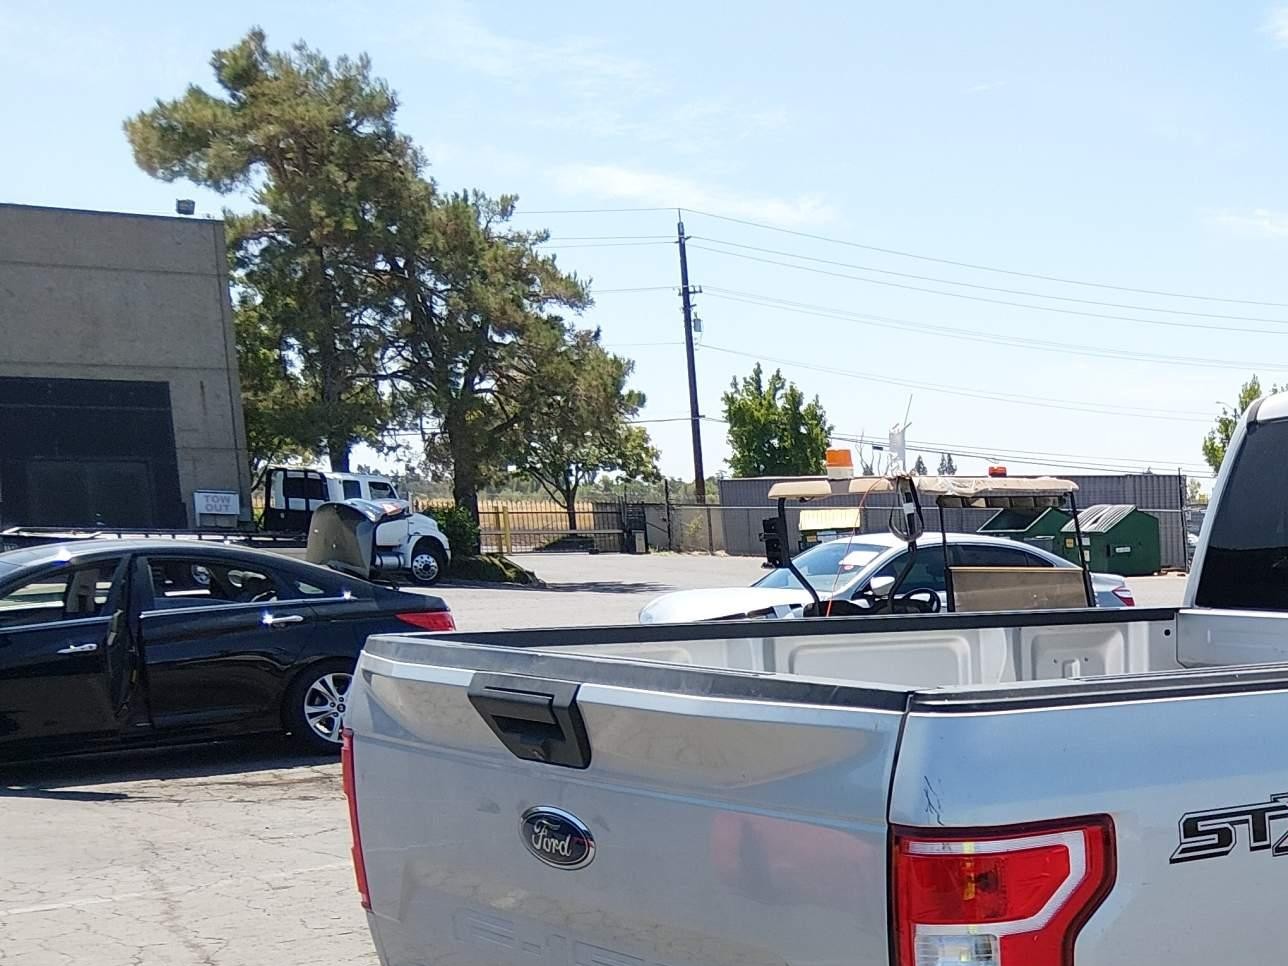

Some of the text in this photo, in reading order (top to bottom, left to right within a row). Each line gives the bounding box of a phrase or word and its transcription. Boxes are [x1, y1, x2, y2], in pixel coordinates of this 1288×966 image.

[204, 495, 231, 504] TOW
[205, 503, 230, 512] OUT
[532, 819, 573, 857] Ford
